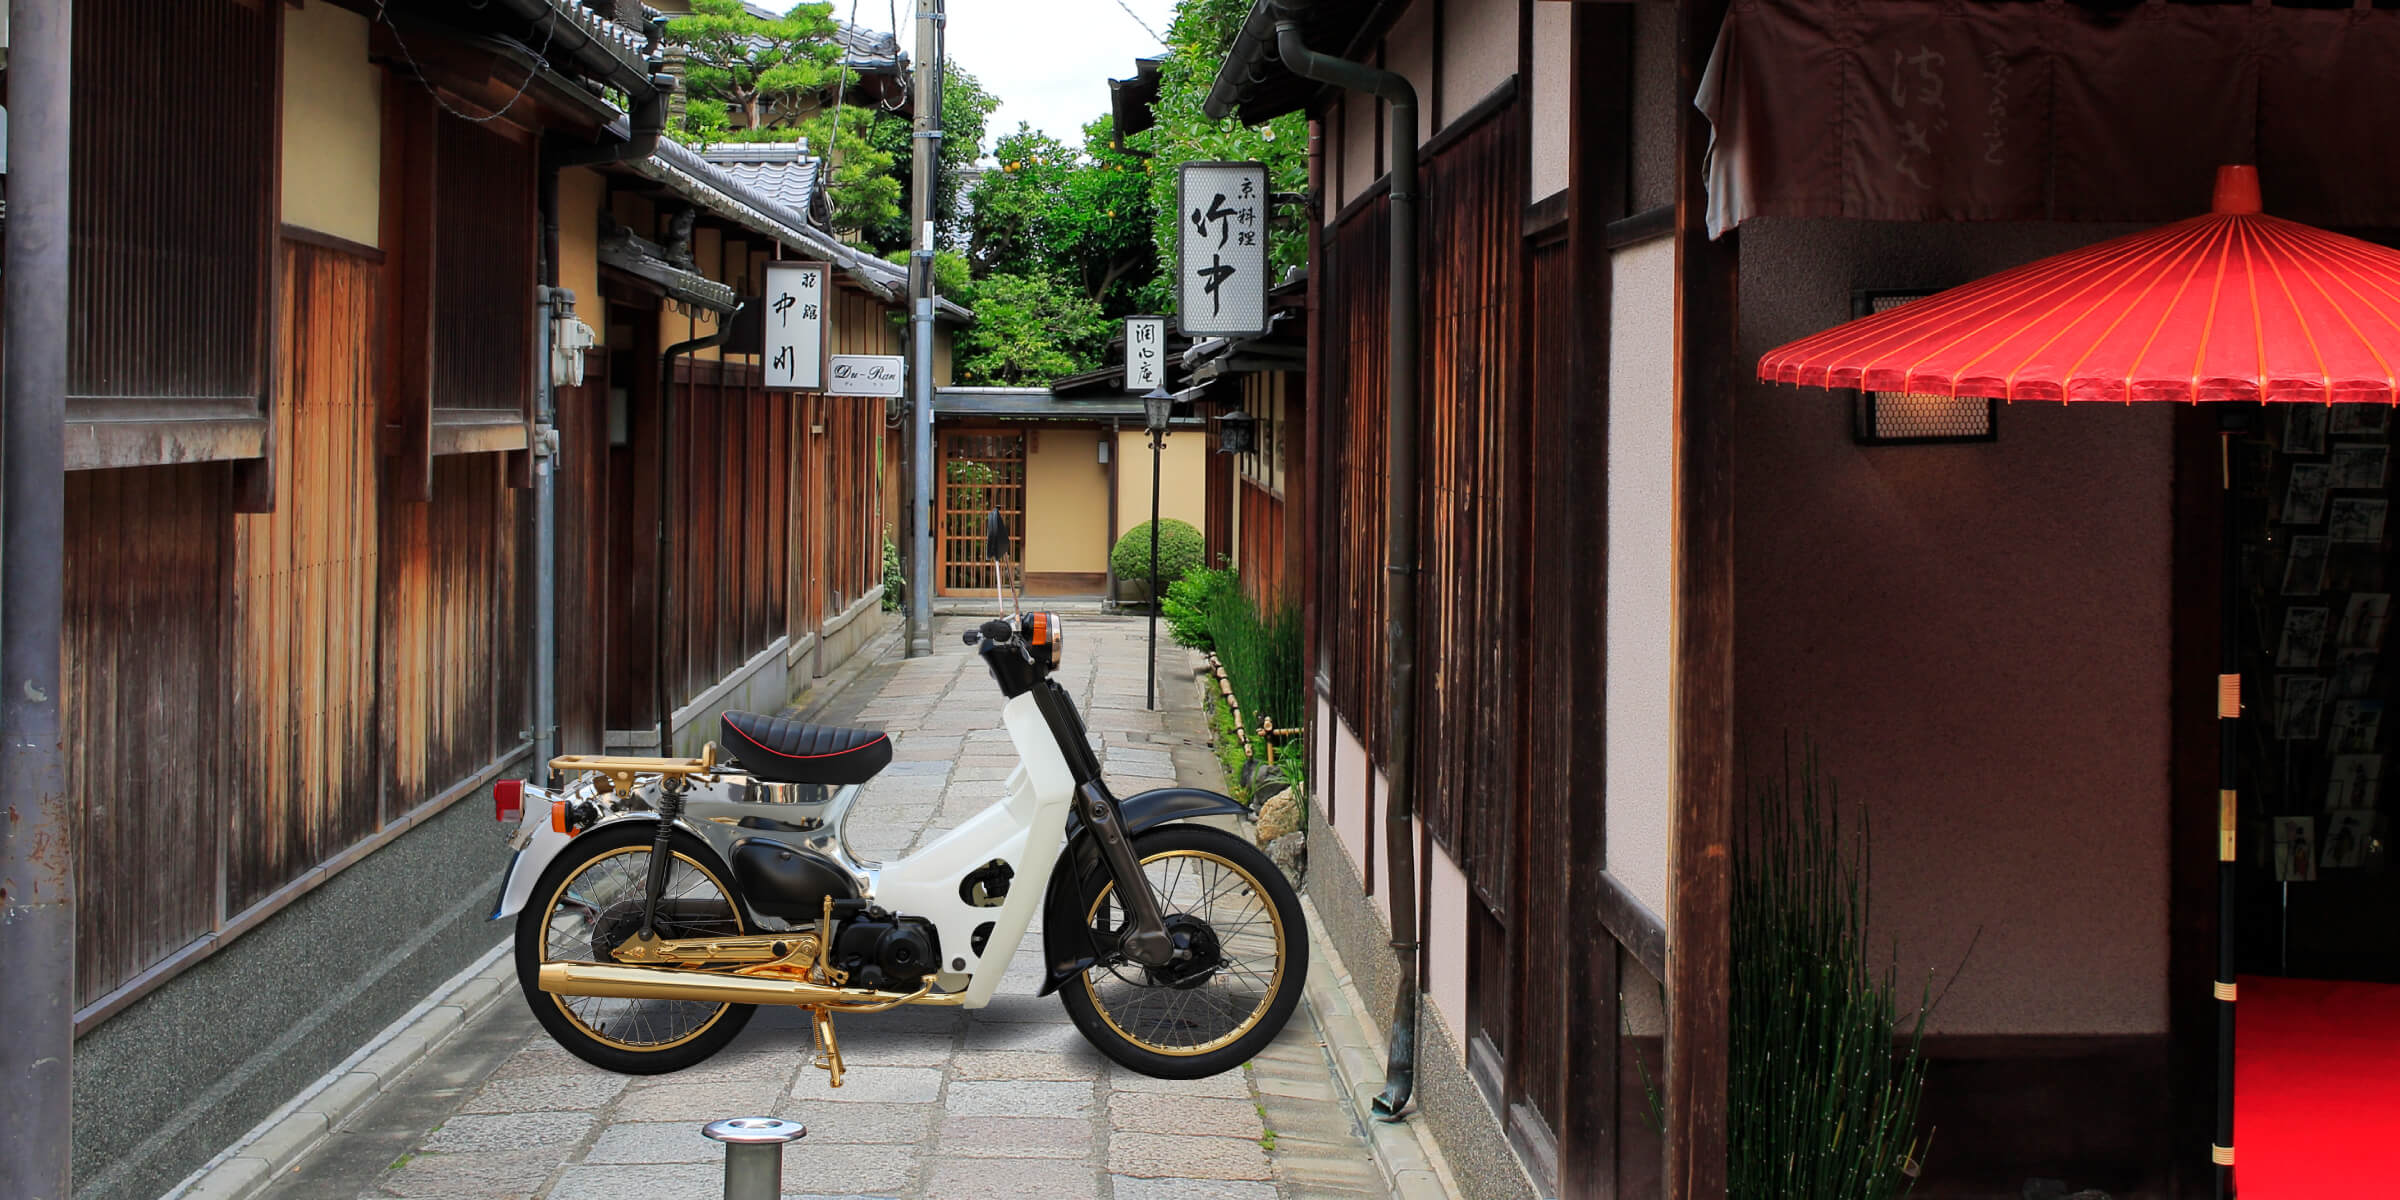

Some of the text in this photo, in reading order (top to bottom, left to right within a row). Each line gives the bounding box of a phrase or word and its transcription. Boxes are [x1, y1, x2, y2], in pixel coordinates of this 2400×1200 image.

[1191, 193, 1238, 318] 竹中
[1237, 177, 1257, 247] 京料理
[772, 292, 796, 384] 中川
